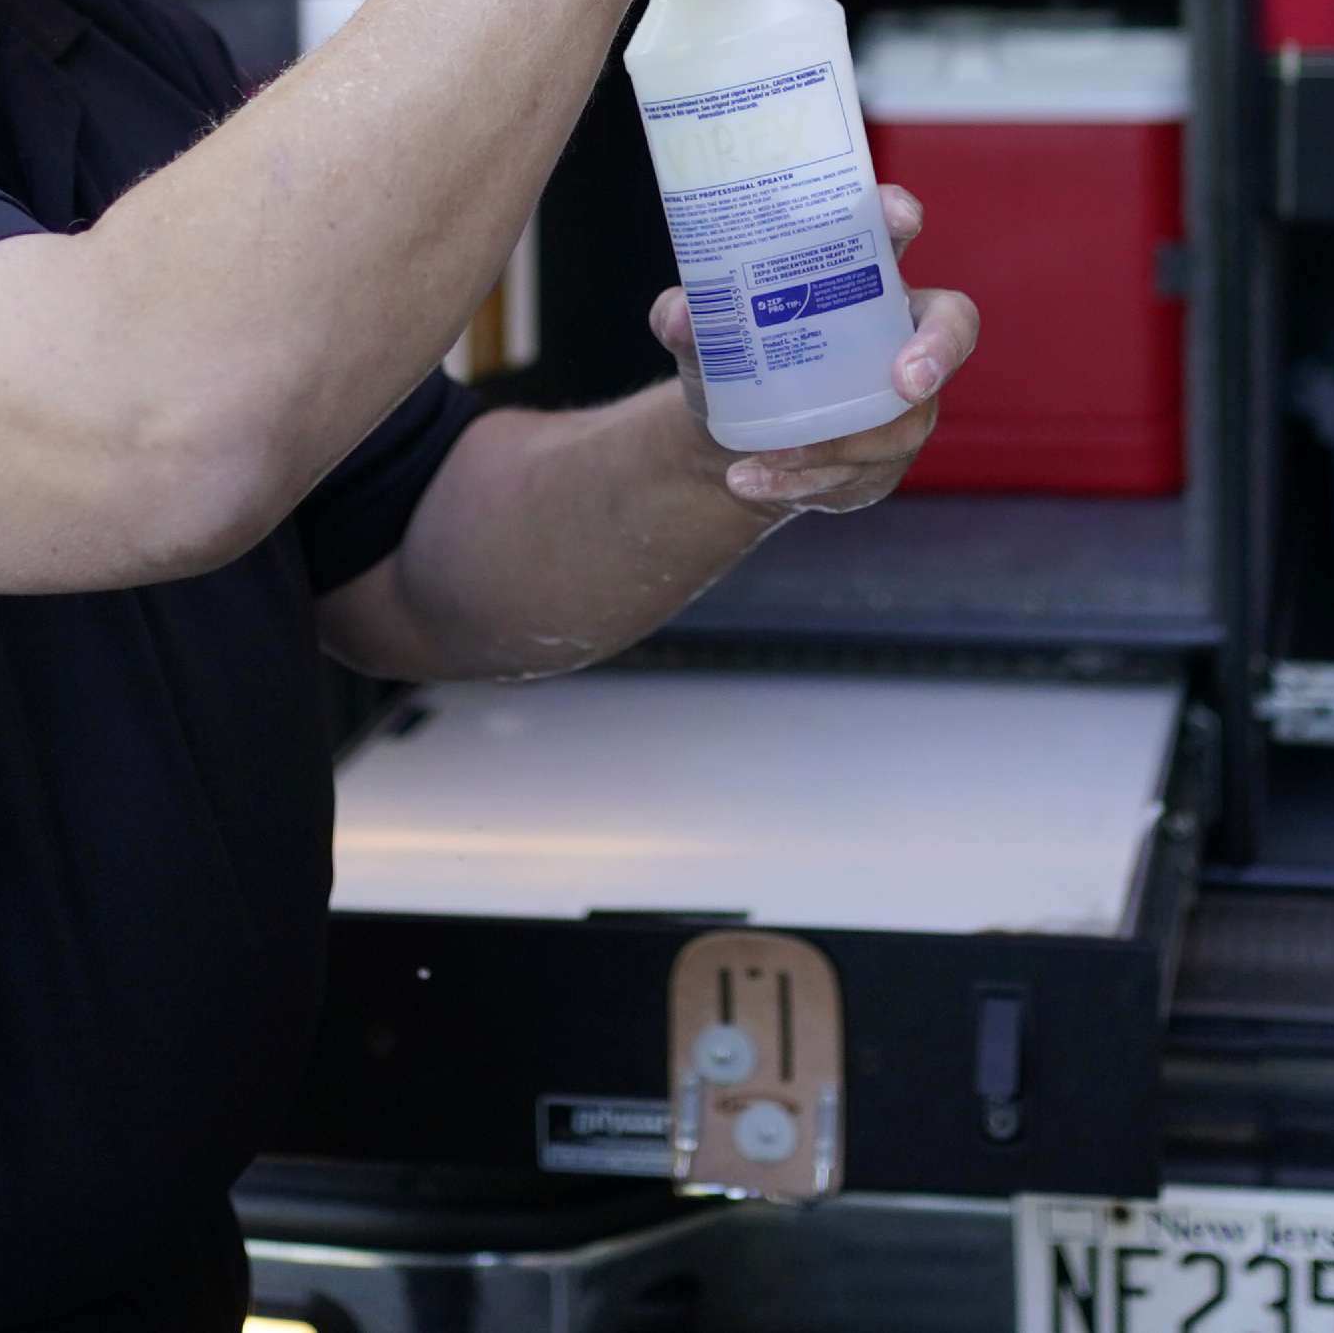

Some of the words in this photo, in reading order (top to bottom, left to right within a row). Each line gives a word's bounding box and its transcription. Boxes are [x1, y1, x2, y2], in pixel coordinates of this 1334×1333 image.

[698, 182, 754, 198] PROFESSIONAL
[757, 172, 793, 186] SPRAYER
[754, 274, 778, 284] CITRUS
[780, 264, 818, 278] DEGREASER
[826, 254, 854, 266] CLEANER
[766, 256, 788, 266] TOUGH
[790, 249, 818, 260] KITCHEN
[772, 255, 823, 273] CONCENTRATED
[825, 249, 845, 259] HEAVY
[847, 244, 862, 252] DUTY
[731, 287, 747, 323] 37055
[767, 303, 785, 313] PRO
[741, 329, 757, 366] 21709
[1148, 1209, 1247, 1245] New
